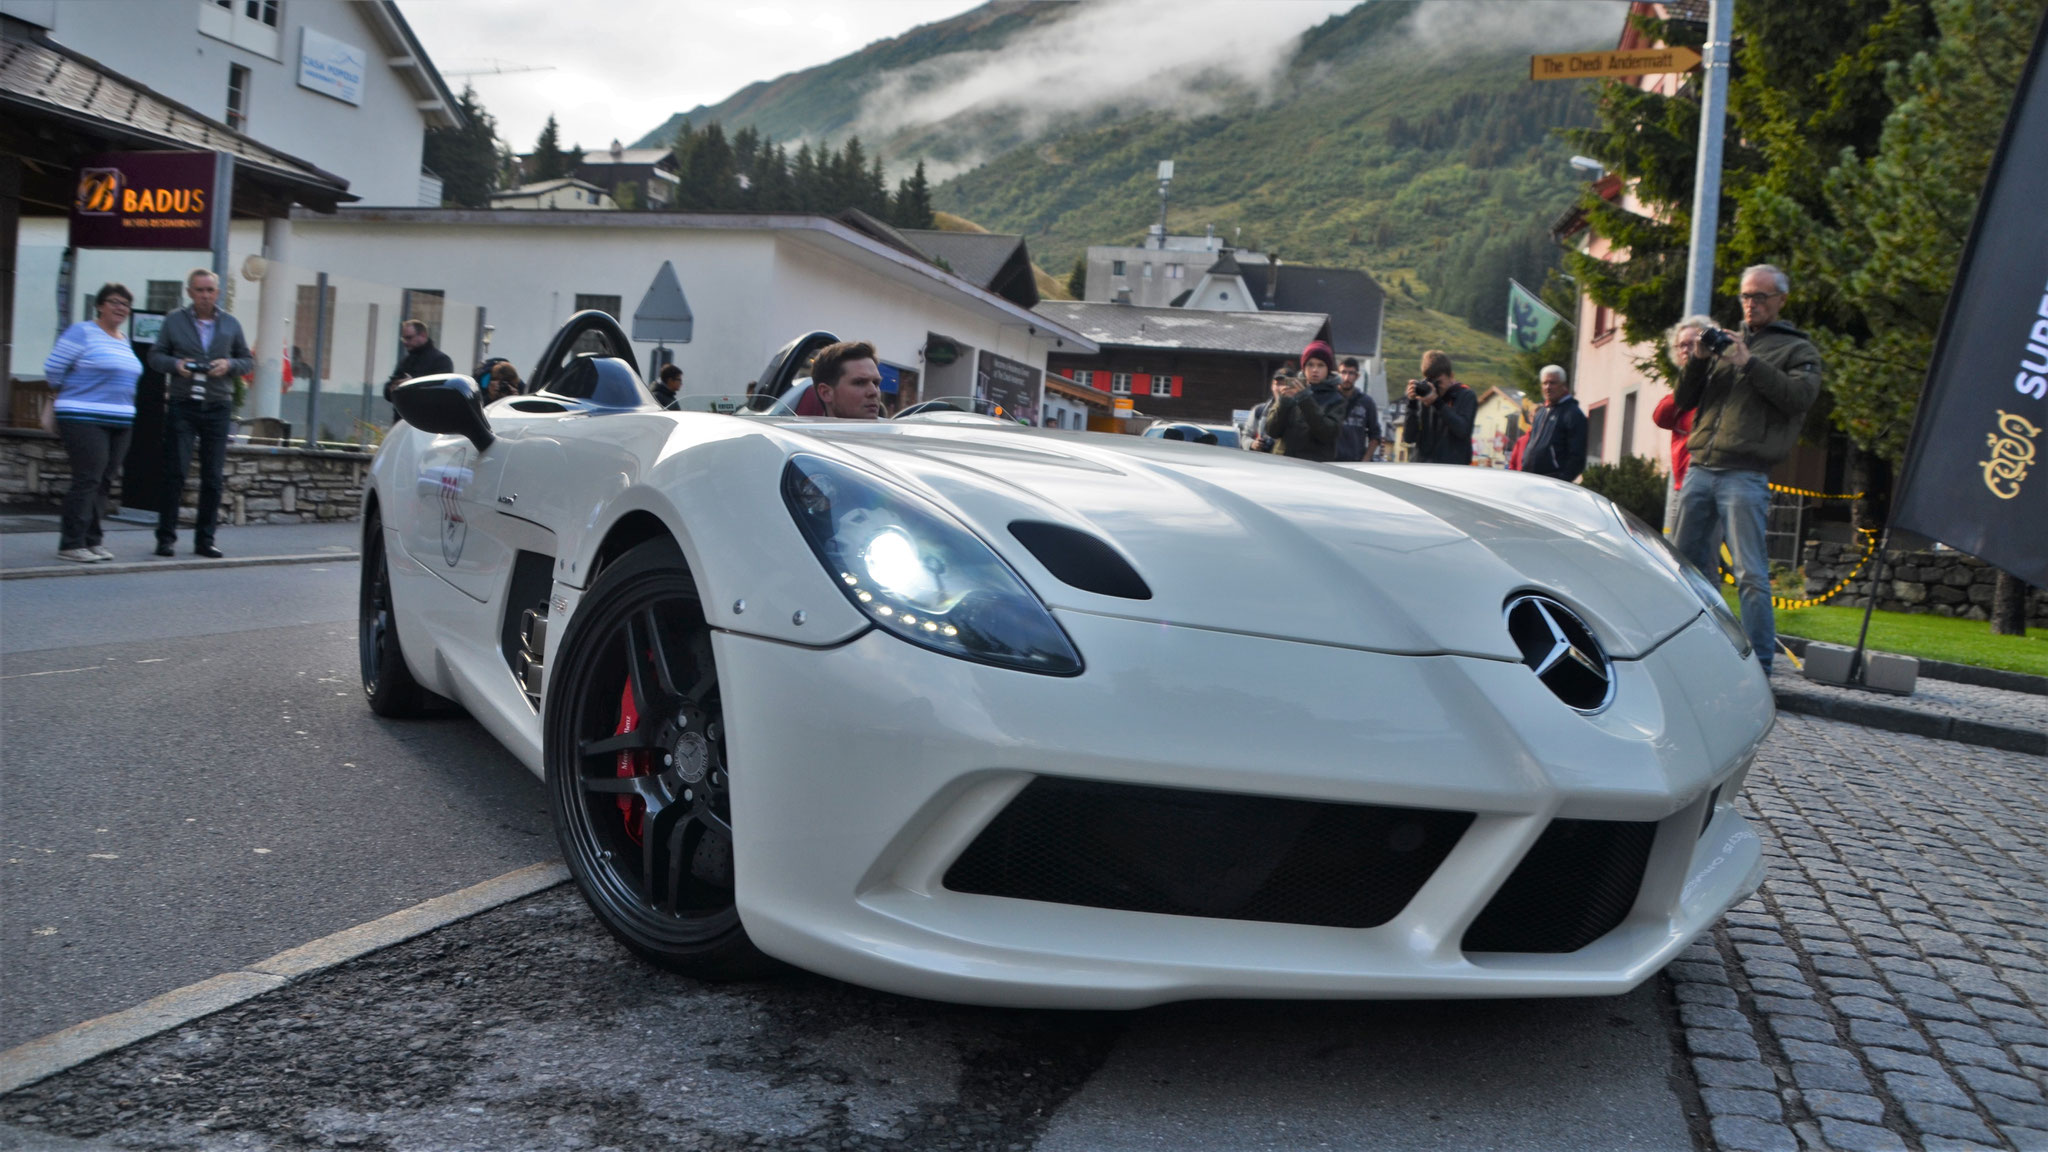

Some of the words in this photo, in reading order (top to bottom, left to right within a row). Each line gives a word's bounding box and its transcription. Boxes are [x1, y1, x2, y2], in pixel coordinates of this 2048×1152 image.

[1543, 58, 1564, 73] The
[1569, 55, 1603, 71] Chedi
[1608, 53, 1673, 70] Andermatt
[122, 188, 206, 213] BADUS
[2014, 279, 2048, 401] SUP
